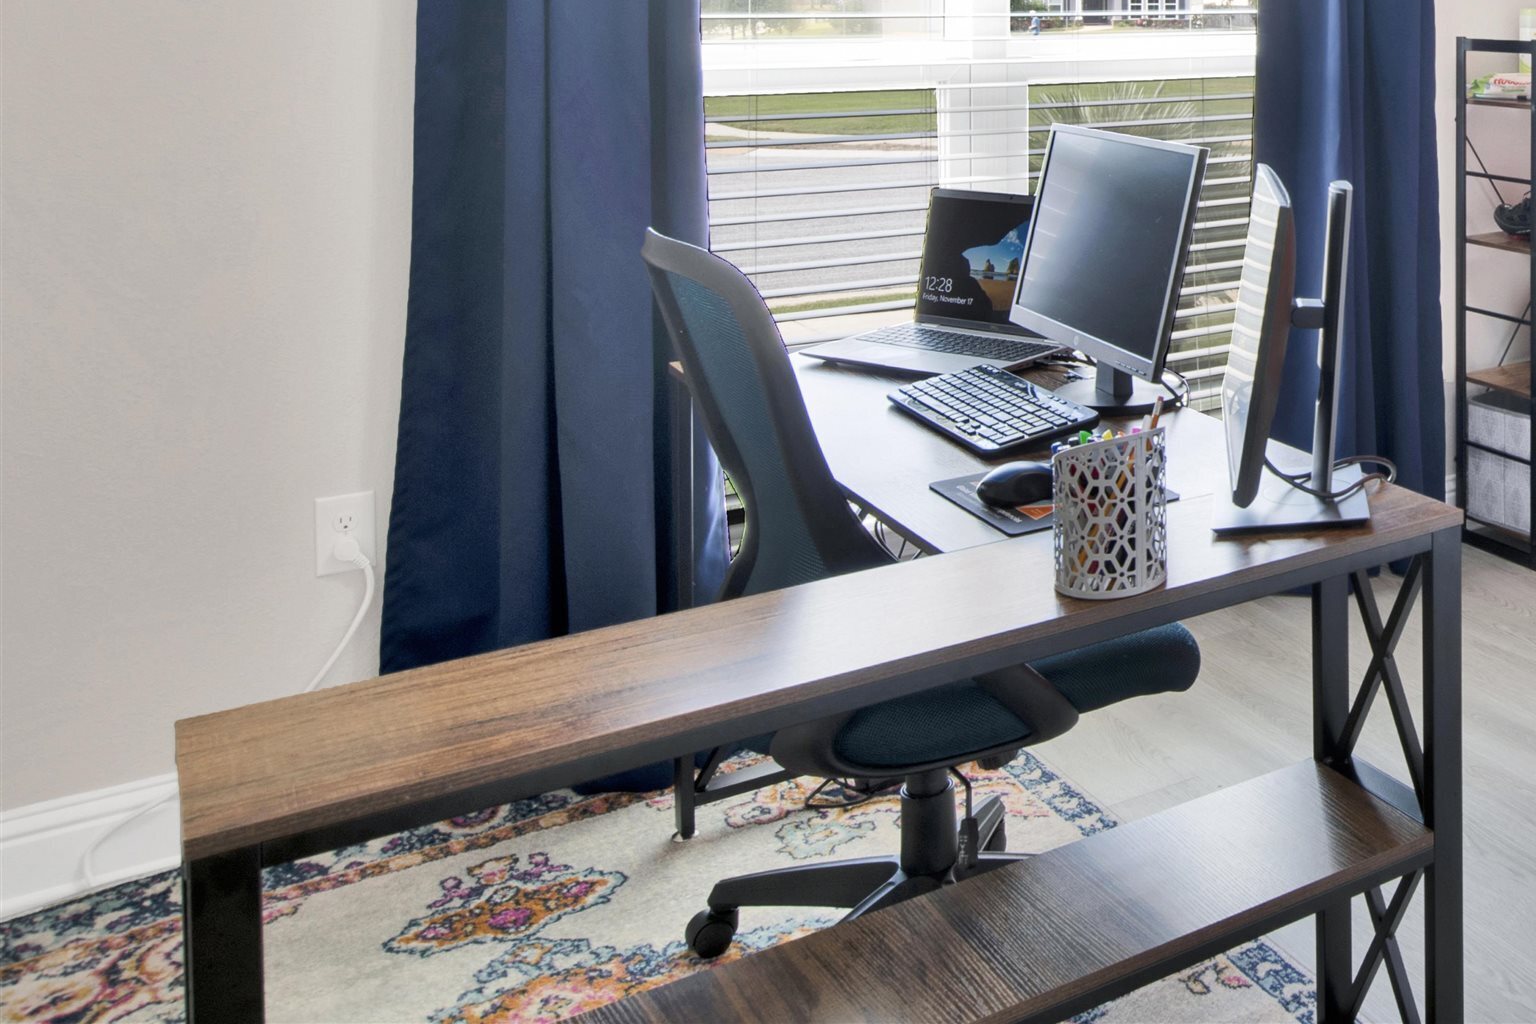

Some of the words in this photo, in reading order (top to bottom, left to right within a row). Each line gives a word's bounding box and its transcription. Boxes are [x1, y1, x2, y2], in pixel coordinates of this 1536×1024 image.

[925, 276, 953, 293] 12:28
[922, 292, 938, 303] Friday,
[939, 295, 966, 305] November
[967, 297, 974, 305] 17
